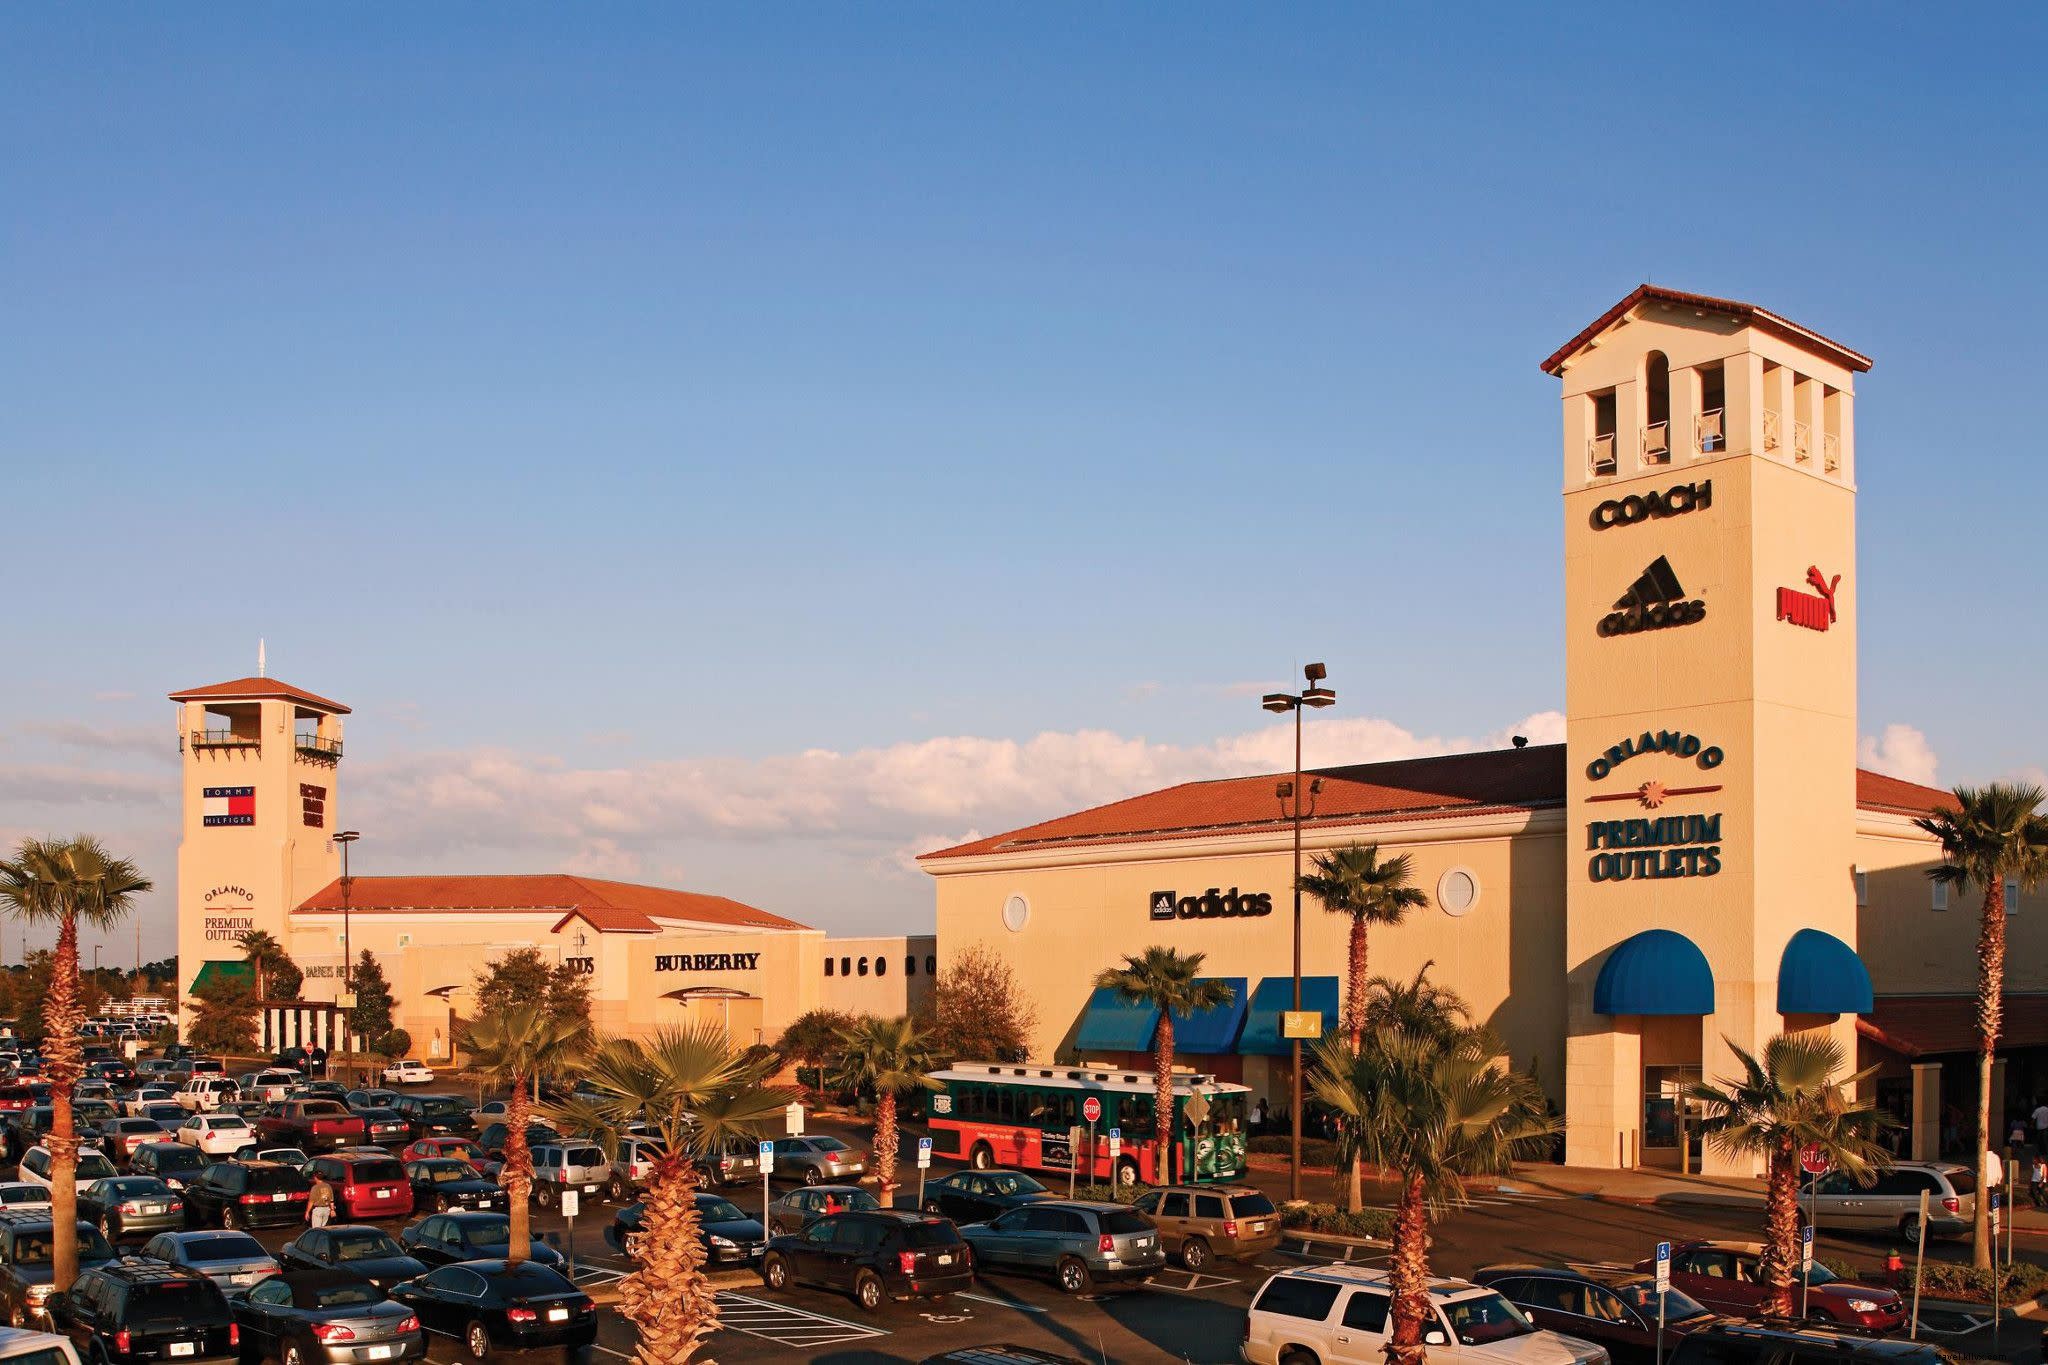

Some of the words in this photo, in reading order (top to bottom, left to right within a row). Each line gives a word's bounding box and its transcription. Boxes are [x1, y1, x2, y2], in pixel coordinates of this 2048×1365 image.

[1589, 479, 1712, 531] COACH
[1596, 598, 1707, 638] adidas
[1586, 729, 1725, 782] ORLANDO
[204, 788, 253, 797] TOMMY
[204, 816, 253, 825] HILFIGER
[1585, 813, 1723, 851] PREMIUM
[1588, 846, 1722, 883] OUTLETS
[204, 885, 254, 901] ORLANDO
[1176, 887, 1273, 919] adidas
[204, 917, 254, 929] PREMIUM
[655, 952, 761, 972] BURBERRY
[1084, 1105, 1100, 1114] STOP
